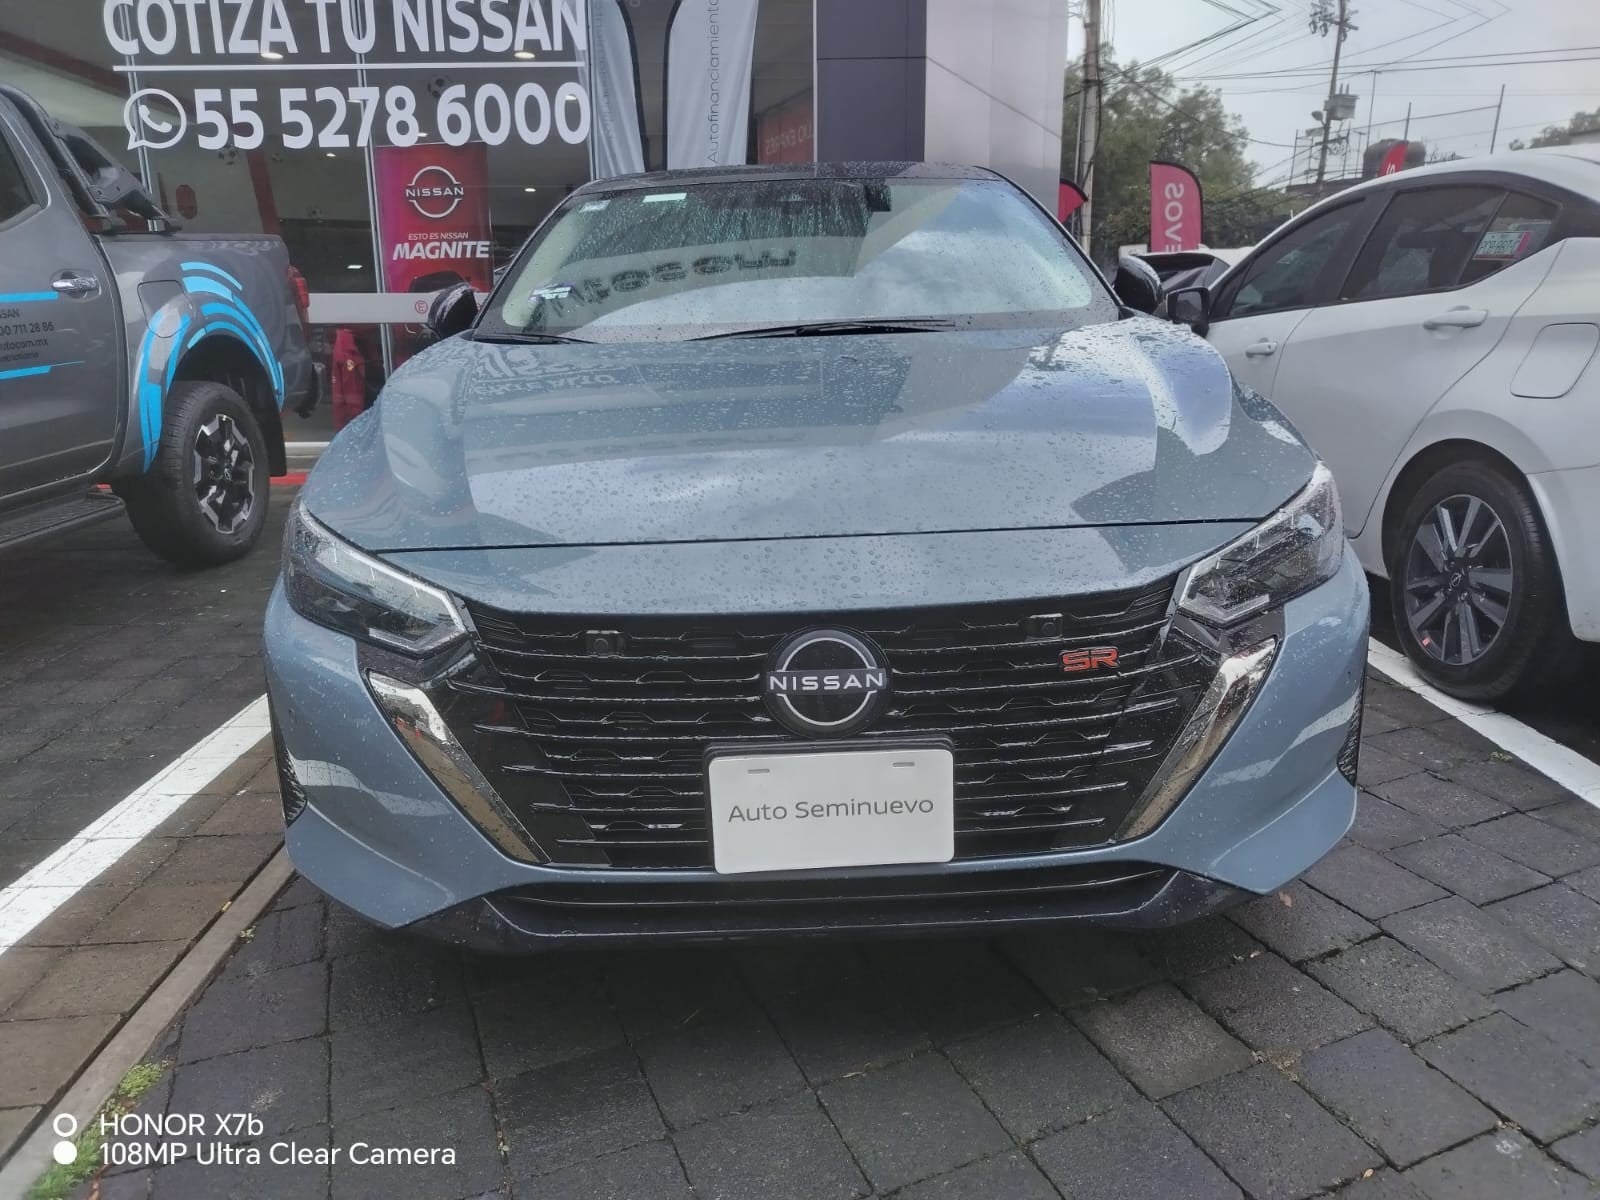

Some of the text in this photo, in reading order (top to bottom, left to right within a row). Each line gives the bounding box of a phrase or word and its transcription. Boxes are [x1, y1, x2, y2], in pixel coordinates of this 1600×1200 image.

[103, 0, 588, 55] COTIZA TU NISSAN
[194, 82, 591, 150] 55 5278 6000
[405, 186, 465, 198] NISSAN
[408, 231, 469, 241] ESTO ES NISSAN
[392, 240, 491, 261] MAGNITE
[1060, 646, 1120, 673] SR
[769, 671, 884, 692] NISSAN
[728, 798, 935, 823] Auto Seminuevo
